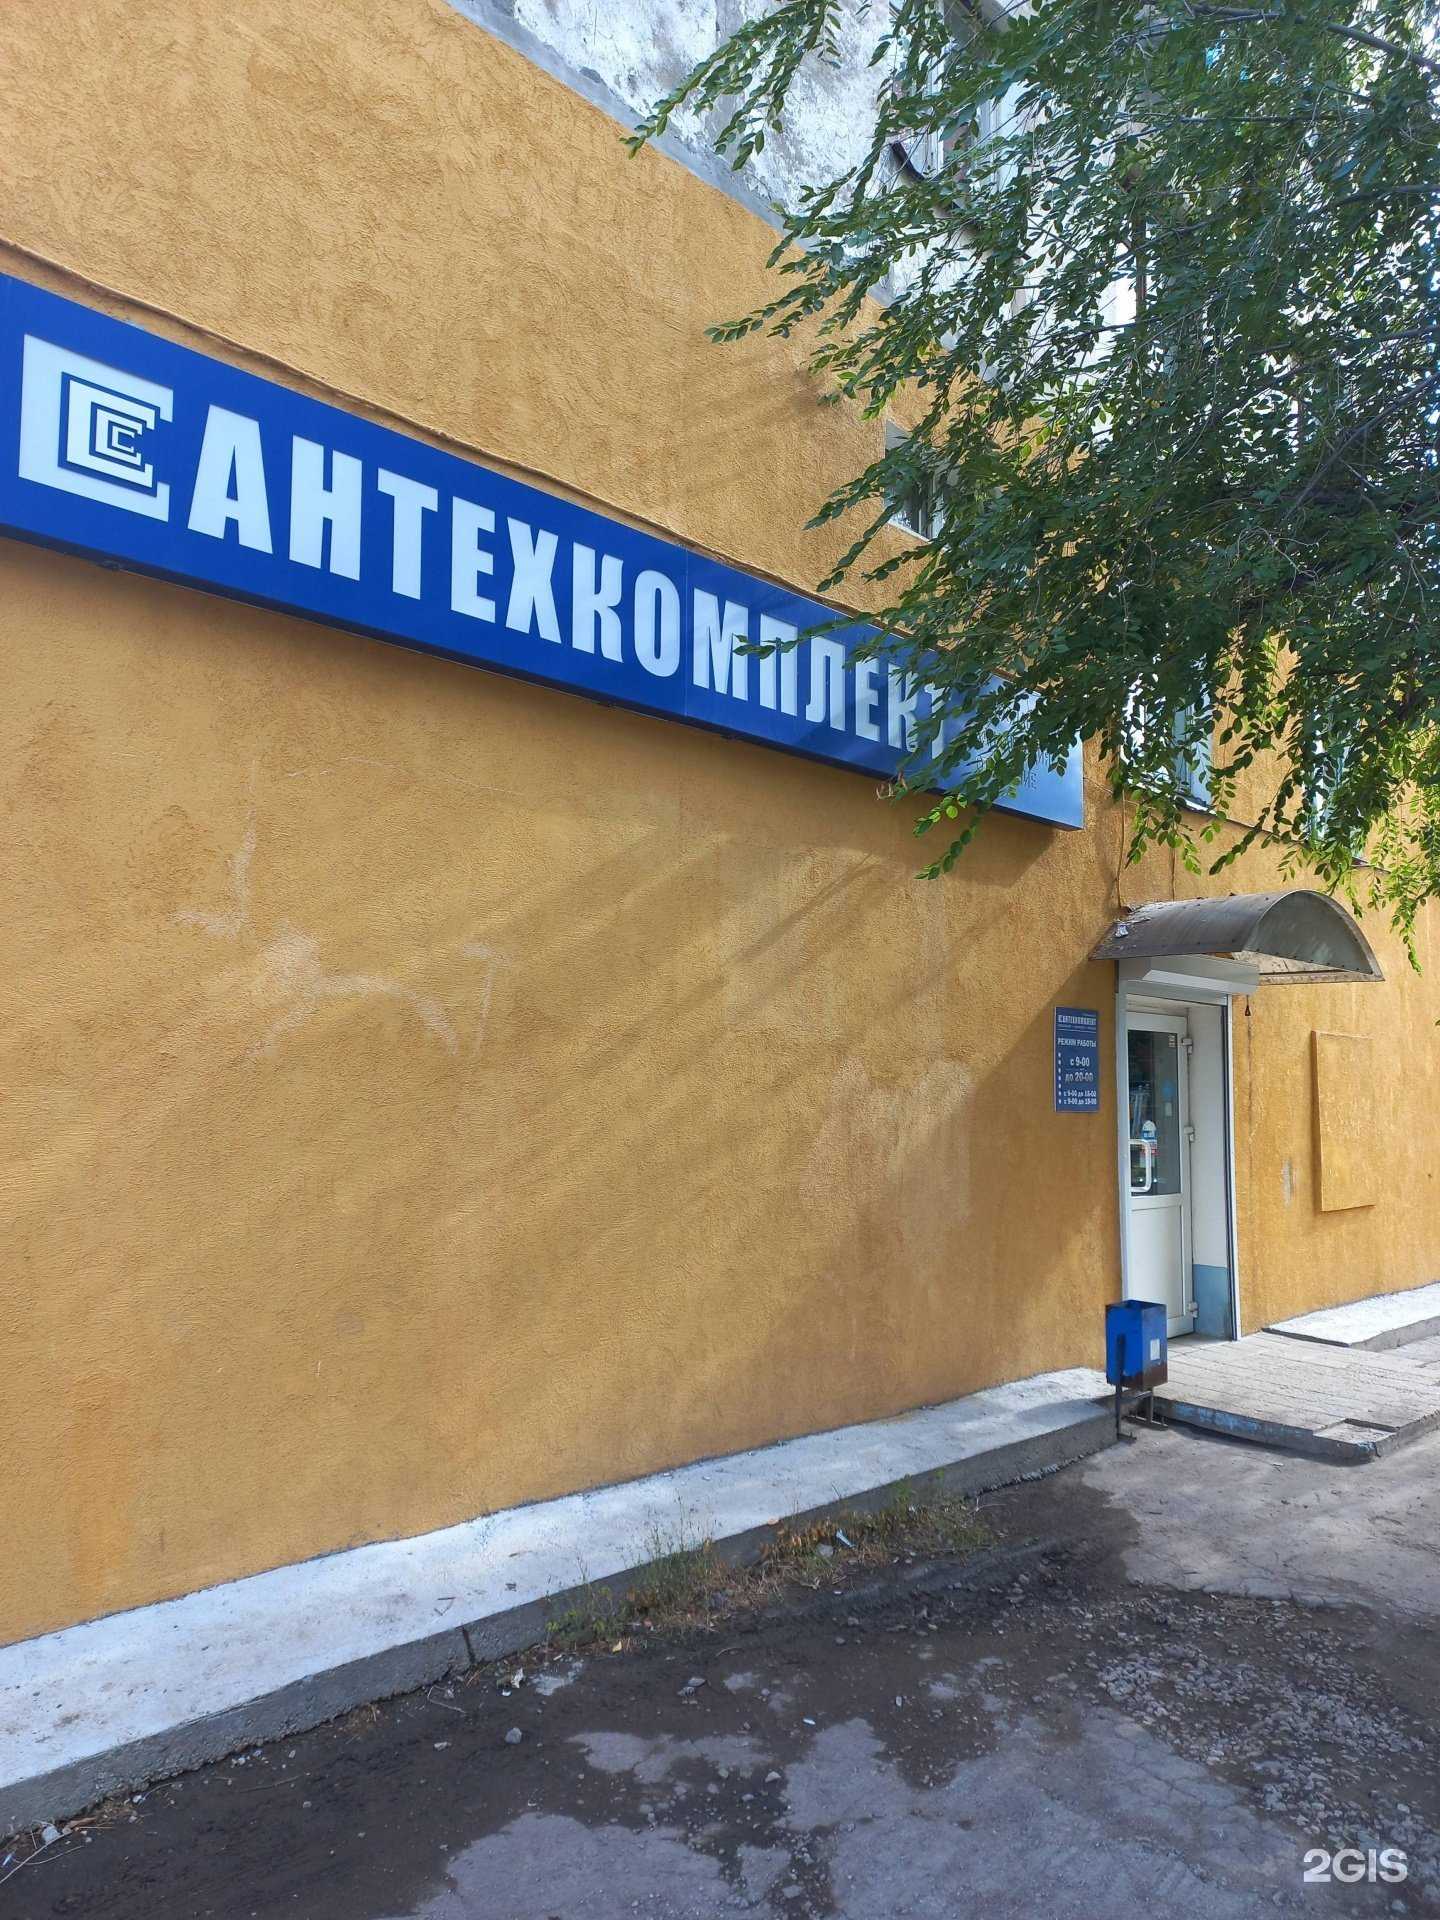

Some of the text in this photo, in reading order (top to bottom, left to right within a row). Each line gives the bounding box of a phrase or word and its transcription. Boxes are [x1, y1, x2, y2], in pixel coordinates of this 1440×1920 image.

[1057, 1037, 1097, 1048] РЕЖИМ РАБОТЫ
[1075, 1056, 1090, 1067] 9-00
[1074, 1073, 1094, 1082] 20-00
